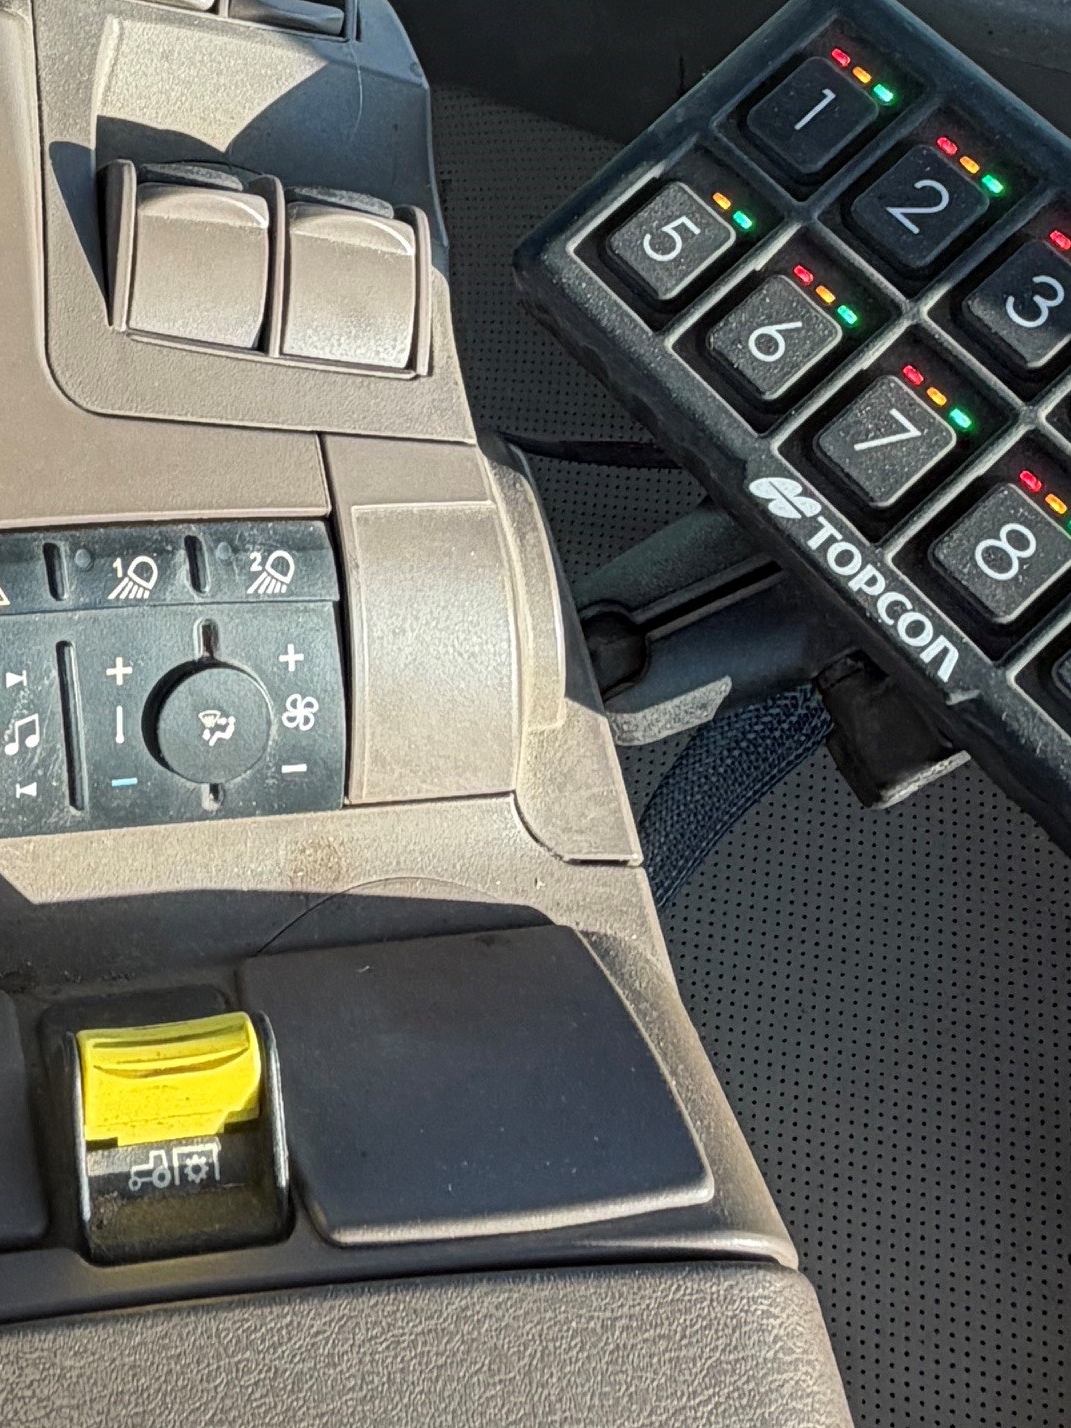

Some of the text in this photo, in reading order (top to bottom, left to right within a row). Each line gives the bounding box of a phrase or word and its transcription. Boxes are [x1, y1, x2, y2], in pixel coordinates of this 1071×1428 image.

[794, 87, 837, 131] 1
[886, 178, 950, 235] 2
[642, 214, 701, 263] 5
[1006, 274, 1065, 329] 3
[747, 319, 804, 363] 6
[853, 408, 922, 451] 7
[112, 557, 123, 578] 1
[249, 552, 263, 572] 2
[974, 522, 1037, 582] 8
[805, 515, 960, 683] TOPCON
